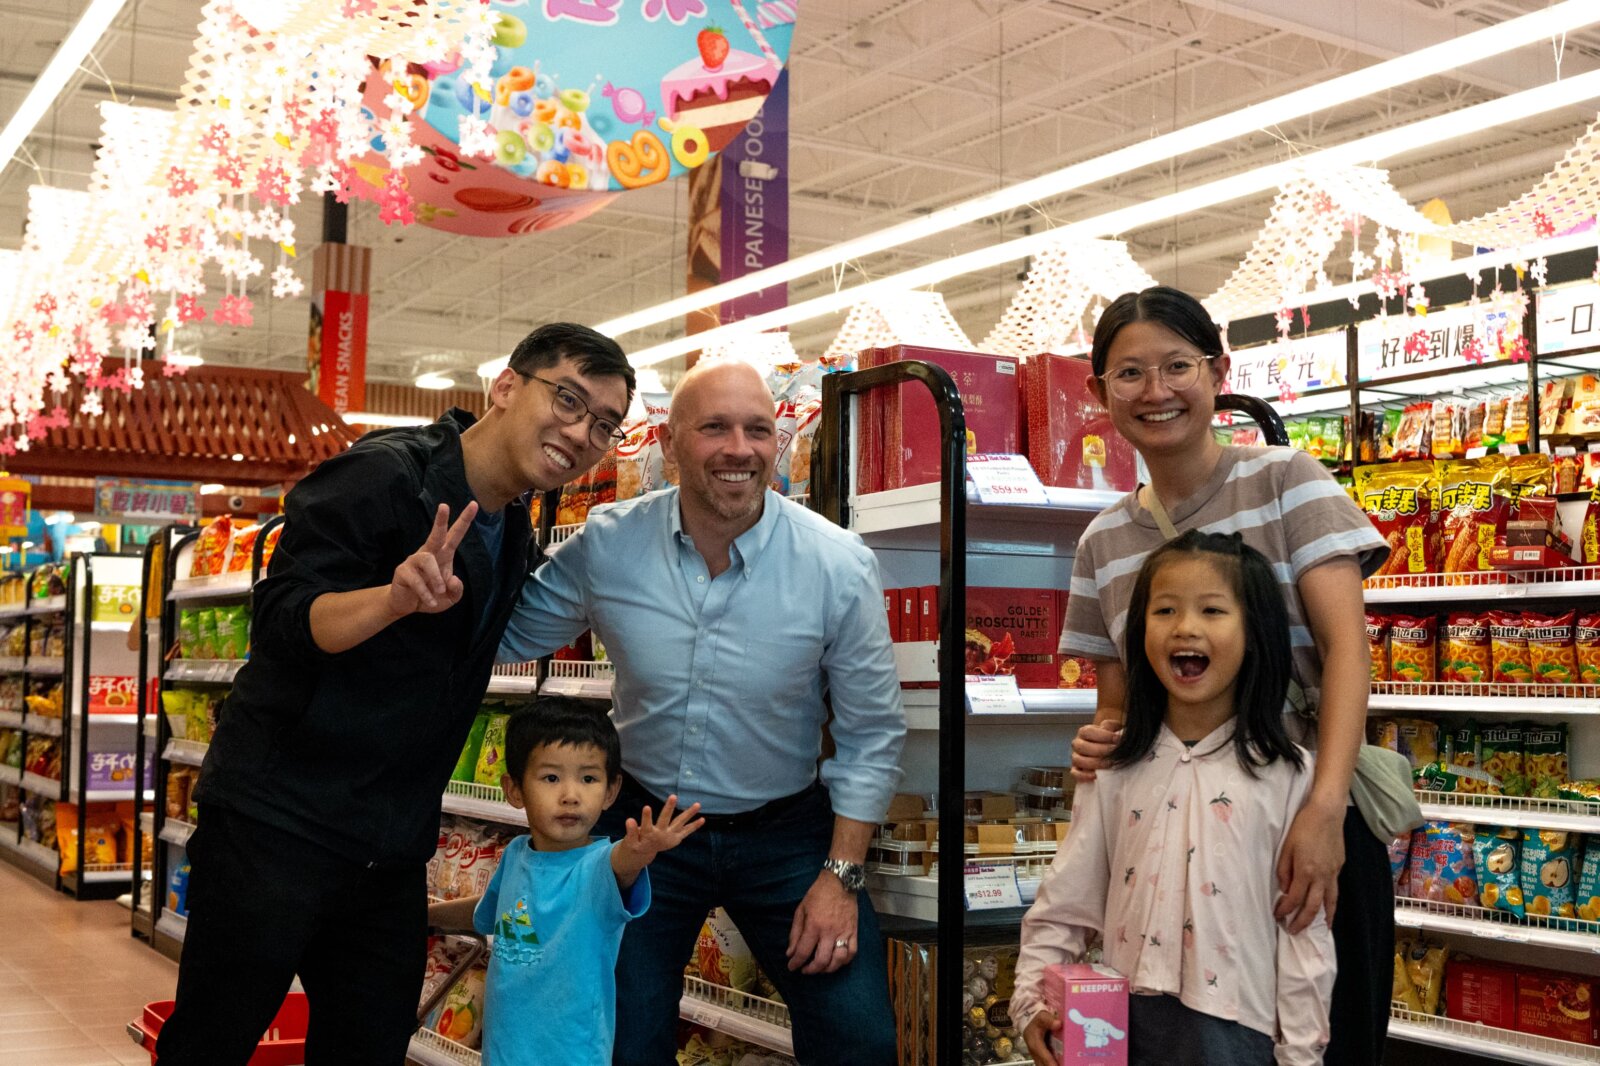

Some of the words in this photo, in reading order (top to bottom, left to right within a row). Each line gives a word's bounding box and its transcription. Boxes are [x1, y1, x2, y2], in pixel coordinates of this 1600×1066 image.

[336, 312, 354, 371] SNACKS
[991, 485, 1028, 494] $59.99
[1007, 606, 1049, 616] GOLDEN
[967, 616, 1049, 629] PROSCIUTTO
[977, 889, 1002, 898] $12.99
[1080, 984, 1124, 993] KEEPPLAY
